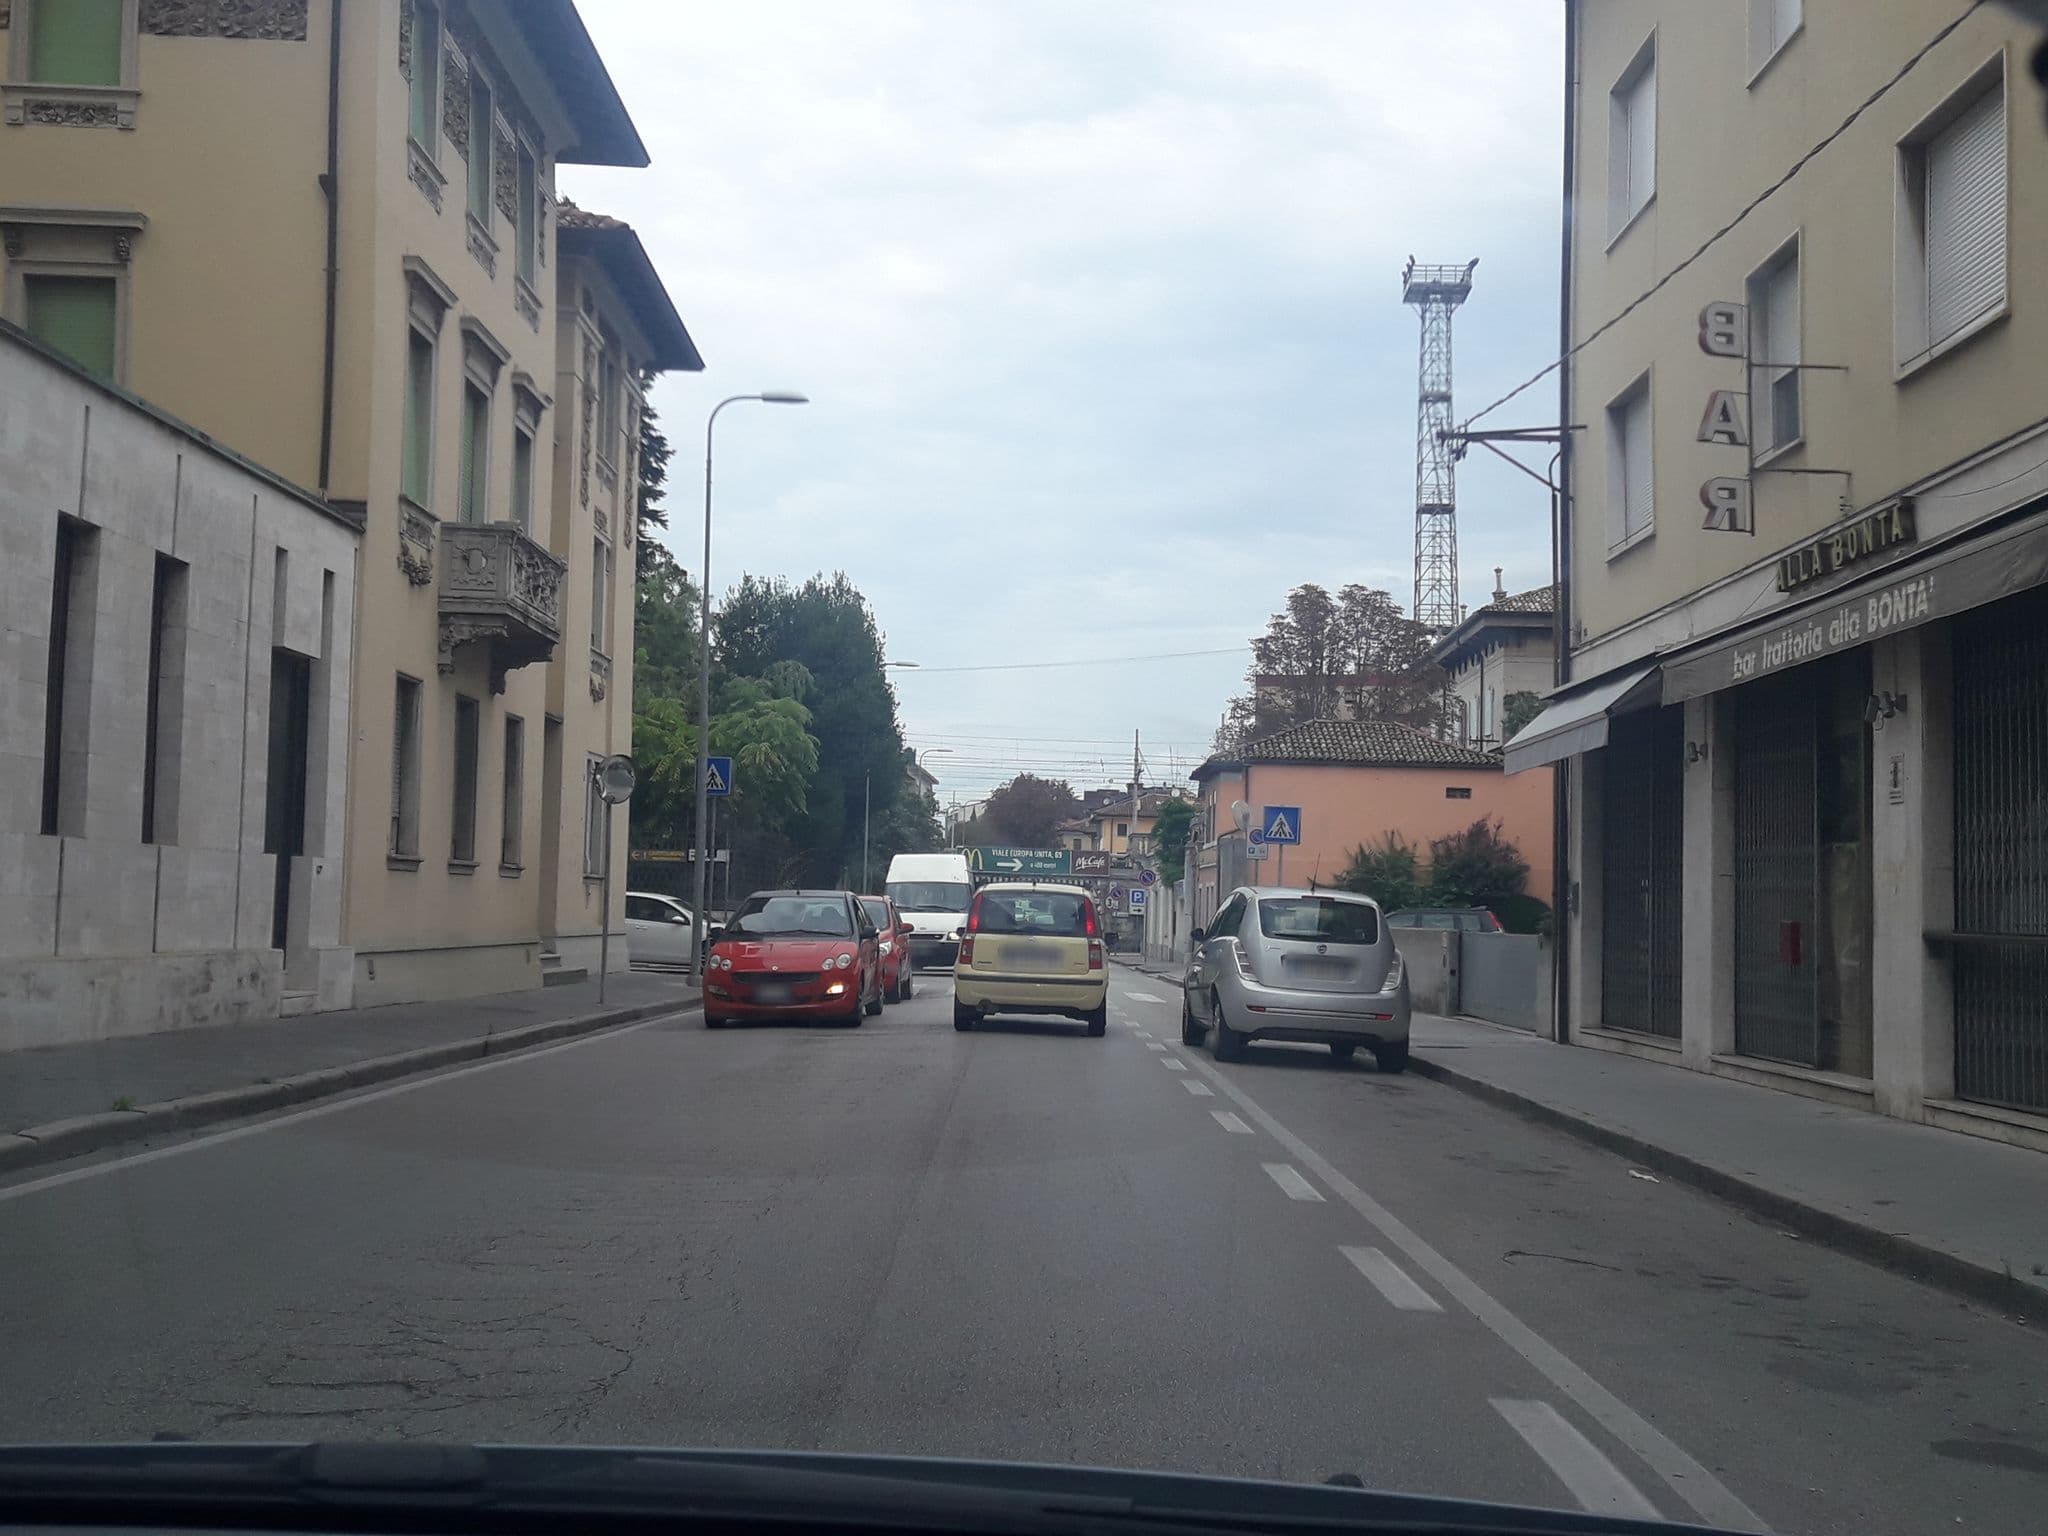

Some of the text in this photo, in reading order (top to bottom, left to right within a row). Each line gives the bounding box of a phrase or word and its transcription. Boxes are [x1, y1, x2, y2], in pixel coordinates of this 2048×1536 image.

[1776, 541, 1822, 592] ALLA
[1733, 650, 1757, 680] bar
[1762, 621, 1823, 670] trattoria
[1828, 607, 1861, 647] alla
[992, 849, 1009, 857] VIALE
[1009, 849, 1033, 858] EUROPA
